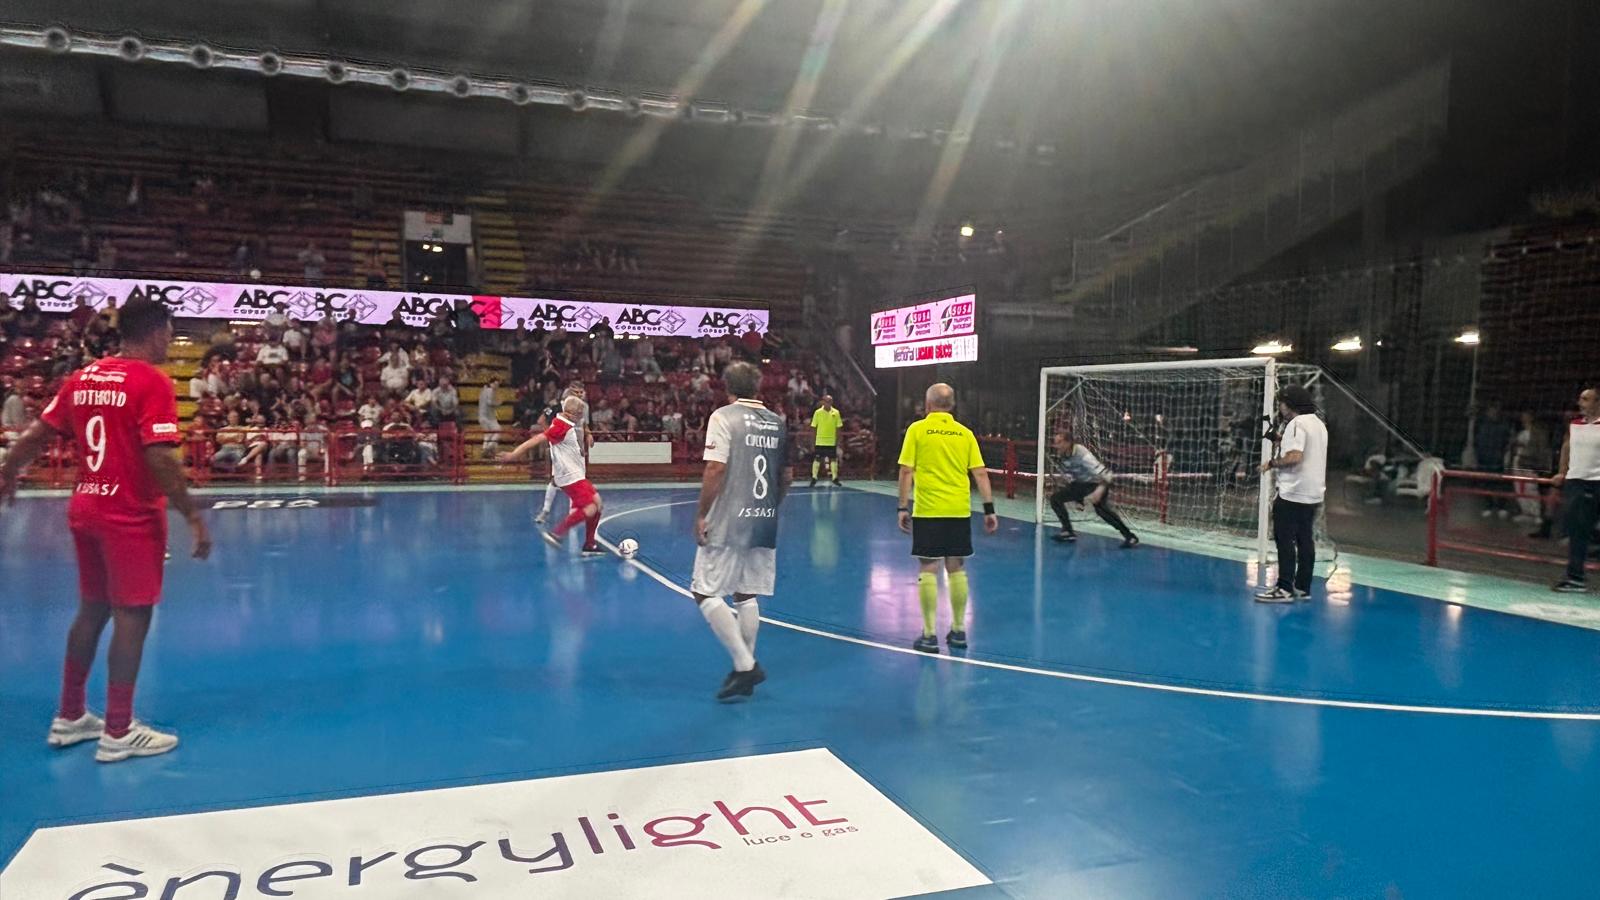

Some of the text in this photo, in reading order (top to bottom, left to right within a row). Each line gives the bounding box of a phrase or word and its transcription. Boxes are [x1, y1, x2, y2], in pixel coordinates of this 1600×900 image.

[10, 280, 73, 300] ABC
[233, 289, 291, 309] ABC
[395, 297, 442, 316] ABC
[528, 304, 577, 322] ABC
[615, 307, 661, 325] ABC
[951, 303, 972, 316] SUSA
[698, 312, 741, 328] ABC
[913, 311, 931, 323] SUSA
[85, 415, 106, 472] 9
[753, 455, 768, 499] 8
[742, 835, 791, 846] luce
[822, 825, 858, 837] gas
